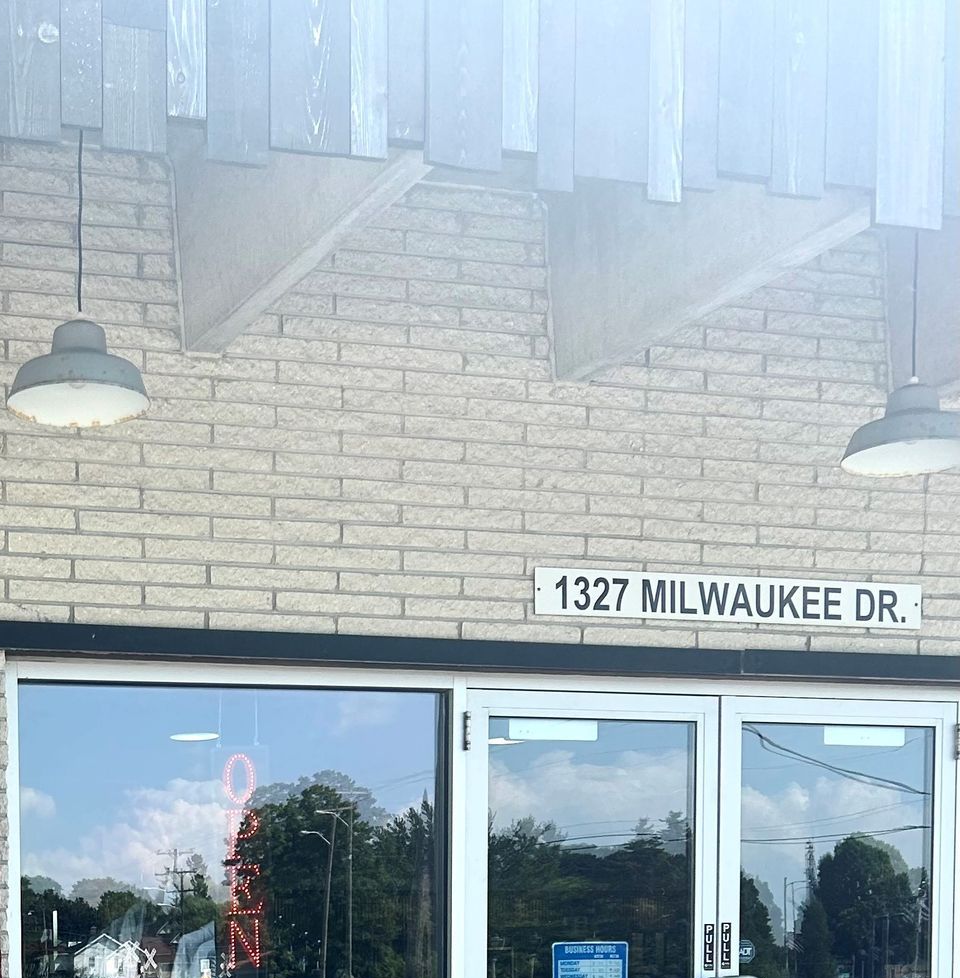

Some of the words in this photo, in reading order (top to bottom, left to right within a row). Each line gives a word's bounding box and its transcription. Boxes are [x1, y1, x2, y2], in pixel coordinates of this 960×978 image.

[555, 575, 630, 612] 1327
[641, 579, 843, 621] MILWAUKEE
[855, 588, 907, 624] DR.
[224, 753, 262, 969] OPEN
[565, 946, 594, 954] BUSINESS
[596, 945, 616, 953] HOURS
